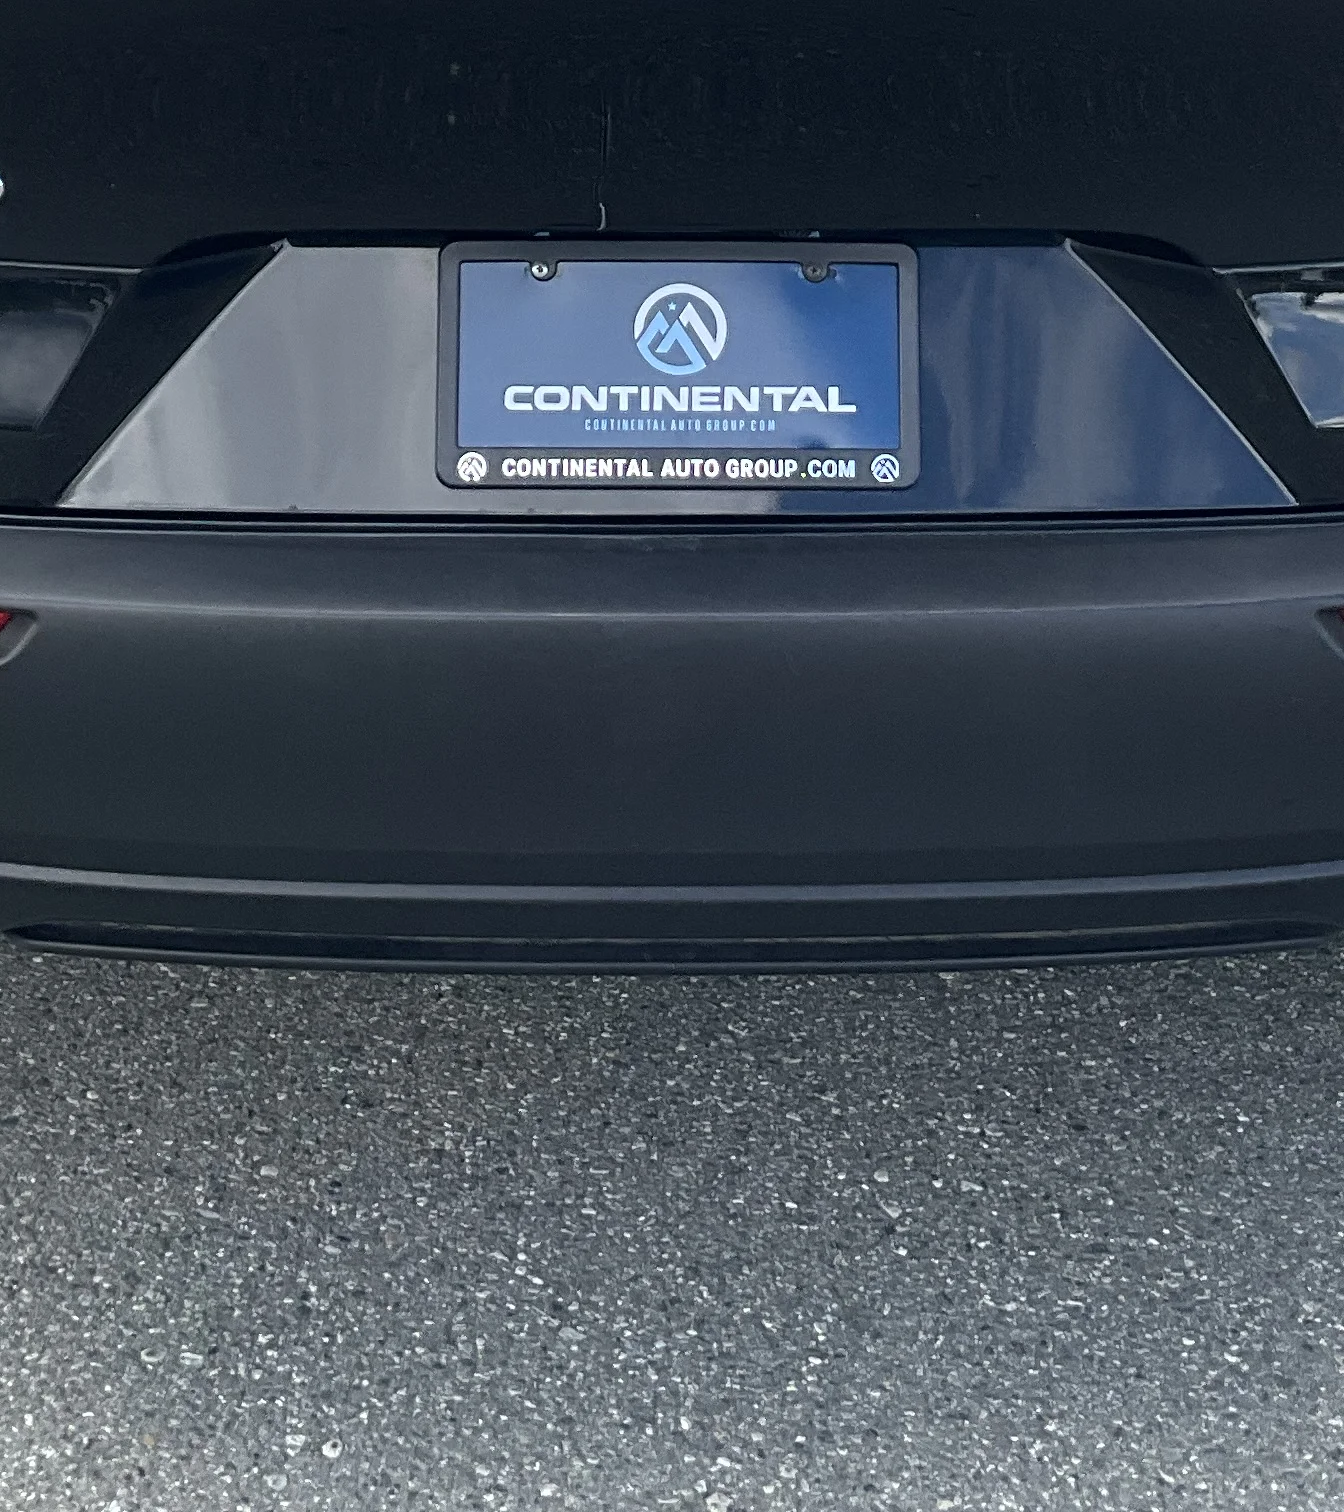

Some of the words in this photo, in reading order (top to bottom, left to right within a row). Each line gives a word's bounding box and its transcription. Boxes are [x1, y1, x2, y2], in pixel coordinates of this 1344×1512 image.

[503, 384, 857, 413] CONTINENTAL
[584, 418, 666, 432] CONTINENTAL
[670, 418, 701, 432] AUTO
[501, 457, 654, 479] CONTINENTAL
[660, 457, 720, 479] AUTO
